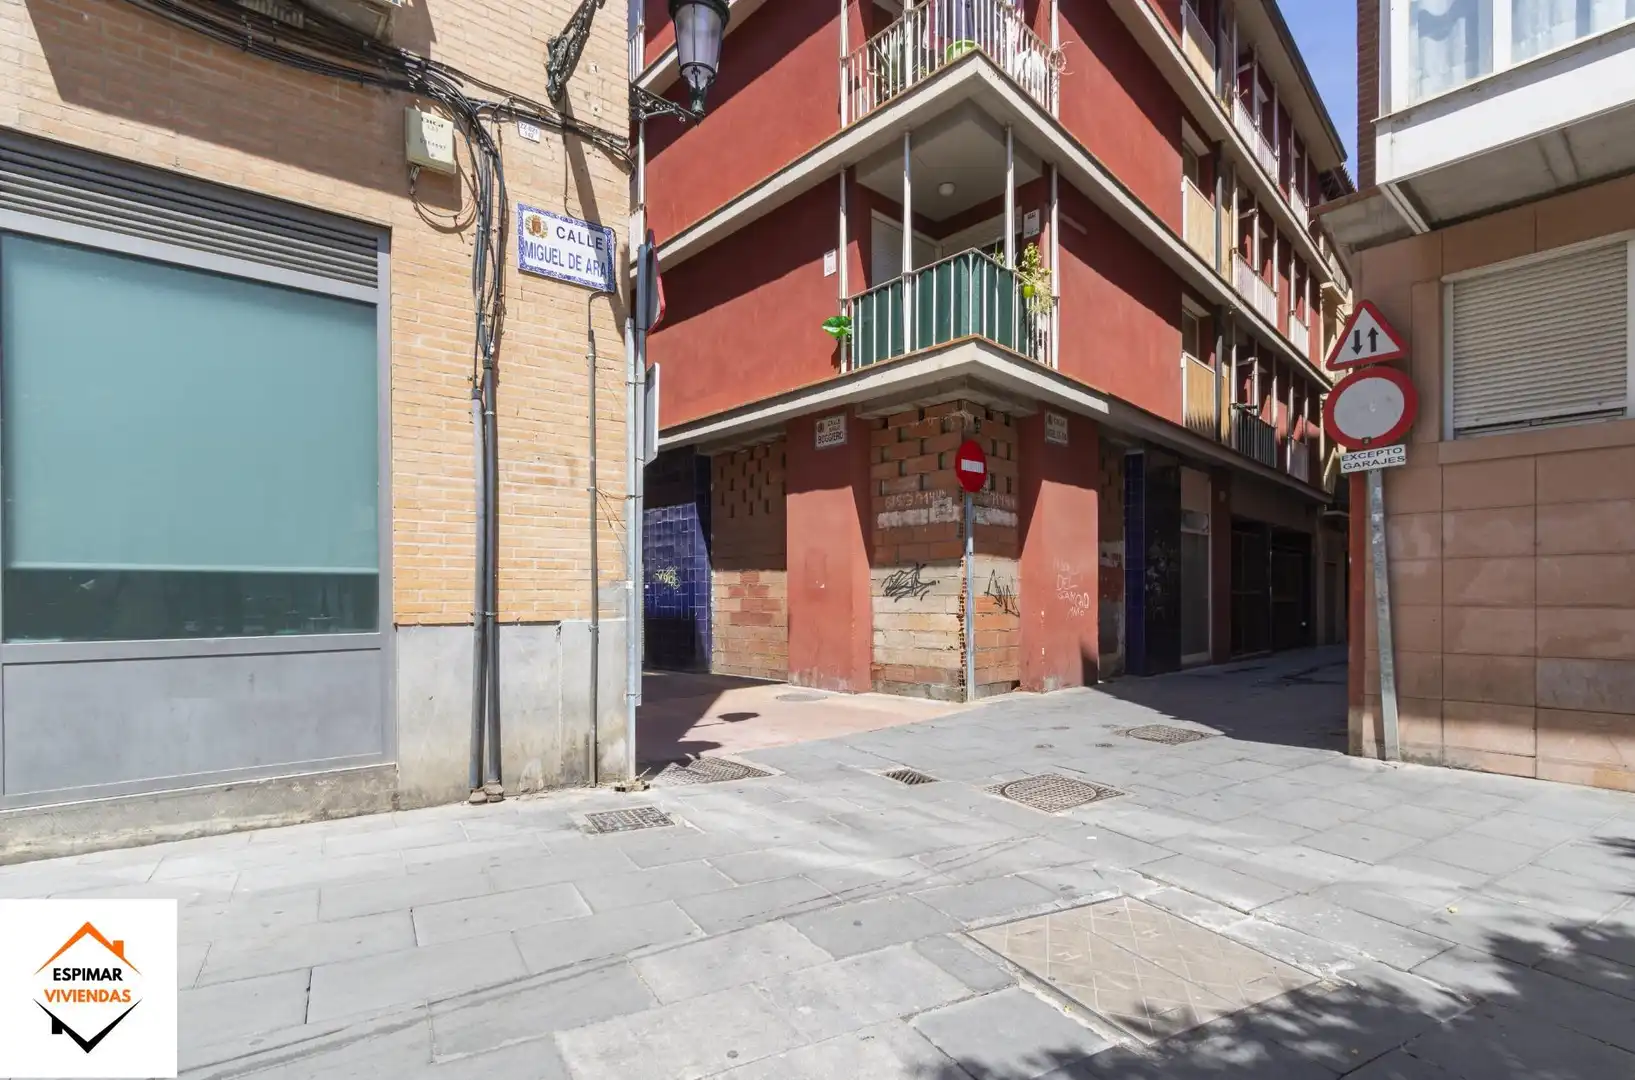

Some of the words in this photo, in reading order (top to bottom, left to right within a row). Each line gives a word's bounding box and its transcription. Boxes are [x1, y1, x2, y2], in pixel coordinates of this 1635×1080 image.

[556, 226, 604, 250] CALLE
[524, 240, 565, 267] MIGUEL
[568, 252, 582, 272] DE
[585, 258, 607, 279] ARA
[1342, 447, 1403, 461] EXCEPTO
[1343, 456, 1405, 470] GARAJES
